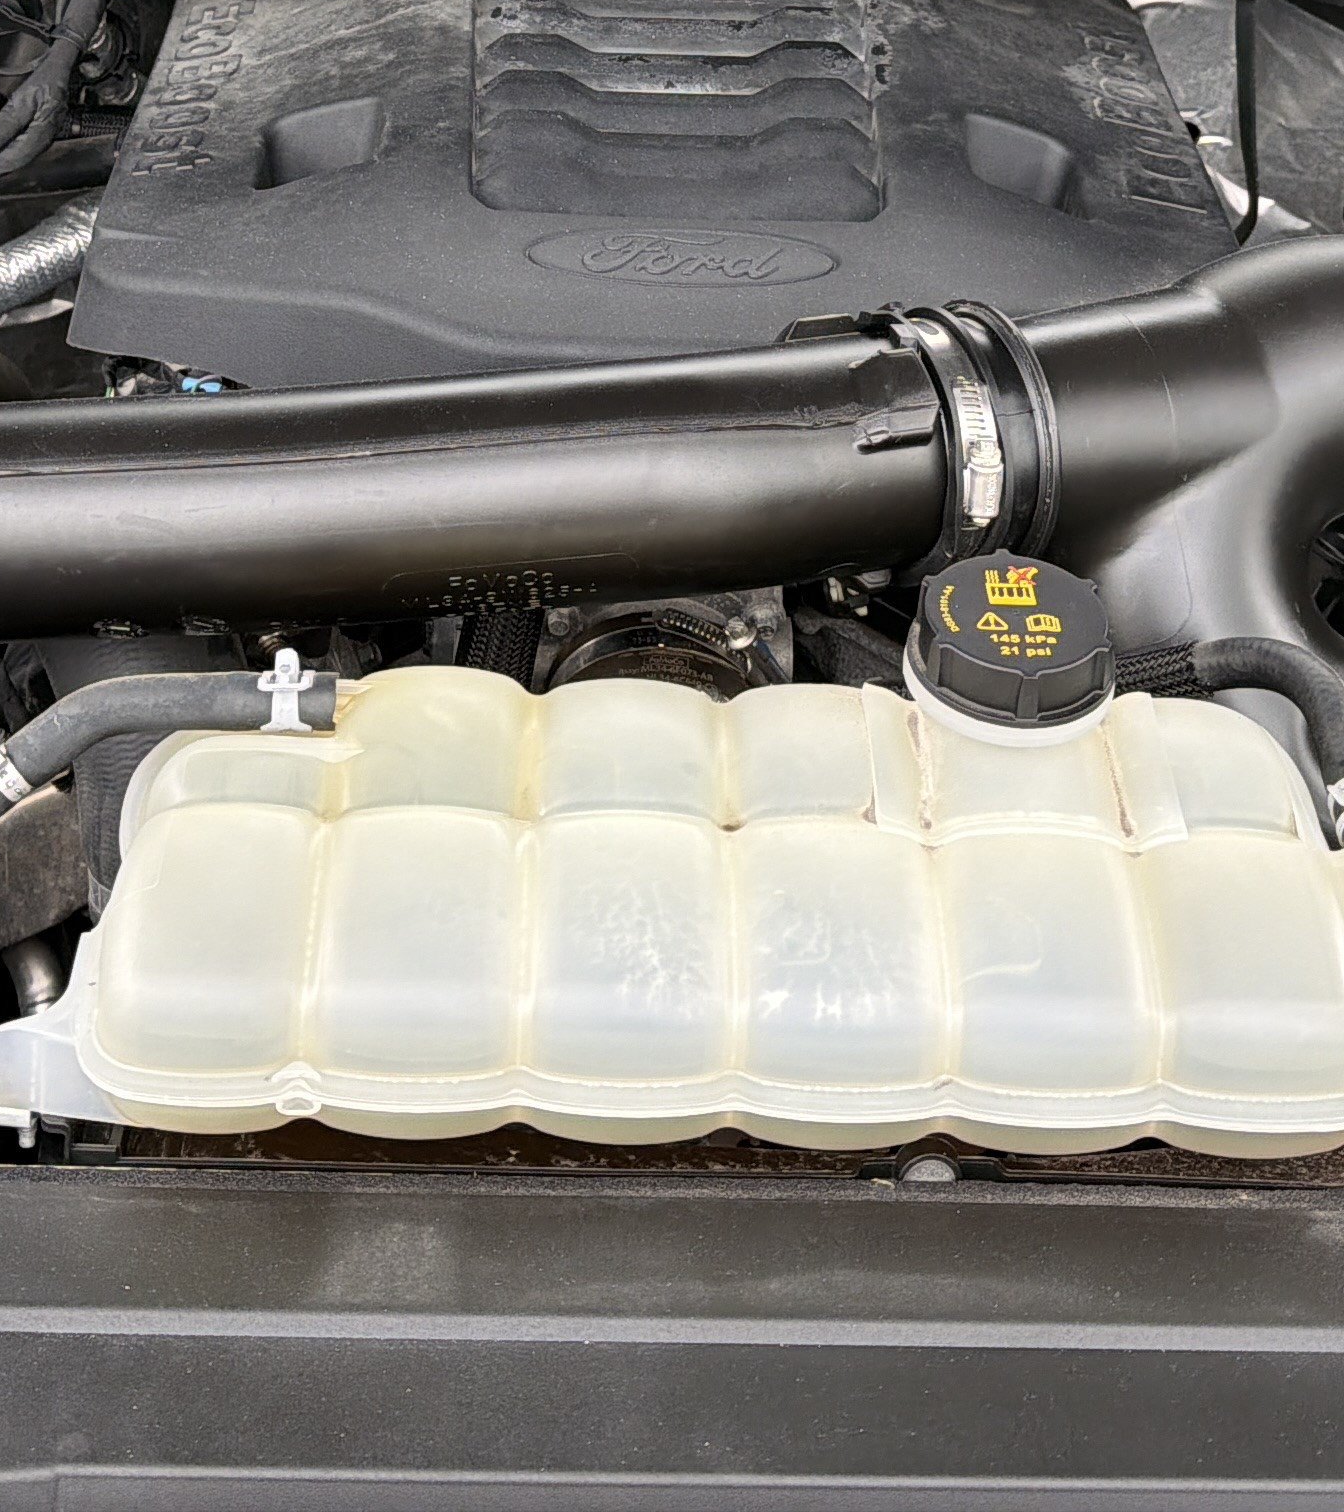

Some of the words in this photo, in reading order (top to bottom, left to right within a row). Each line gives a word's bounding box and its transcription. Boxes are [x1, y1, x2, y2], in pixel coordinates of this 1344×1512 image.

[580, 232, 785, 280] Ford
[990, 634, 1021, 644] 145
[1025, 635, 1057, 644] kPa
[1000, 646, 1020, 656] 21
[1026, 647, 1052, 658] psi
